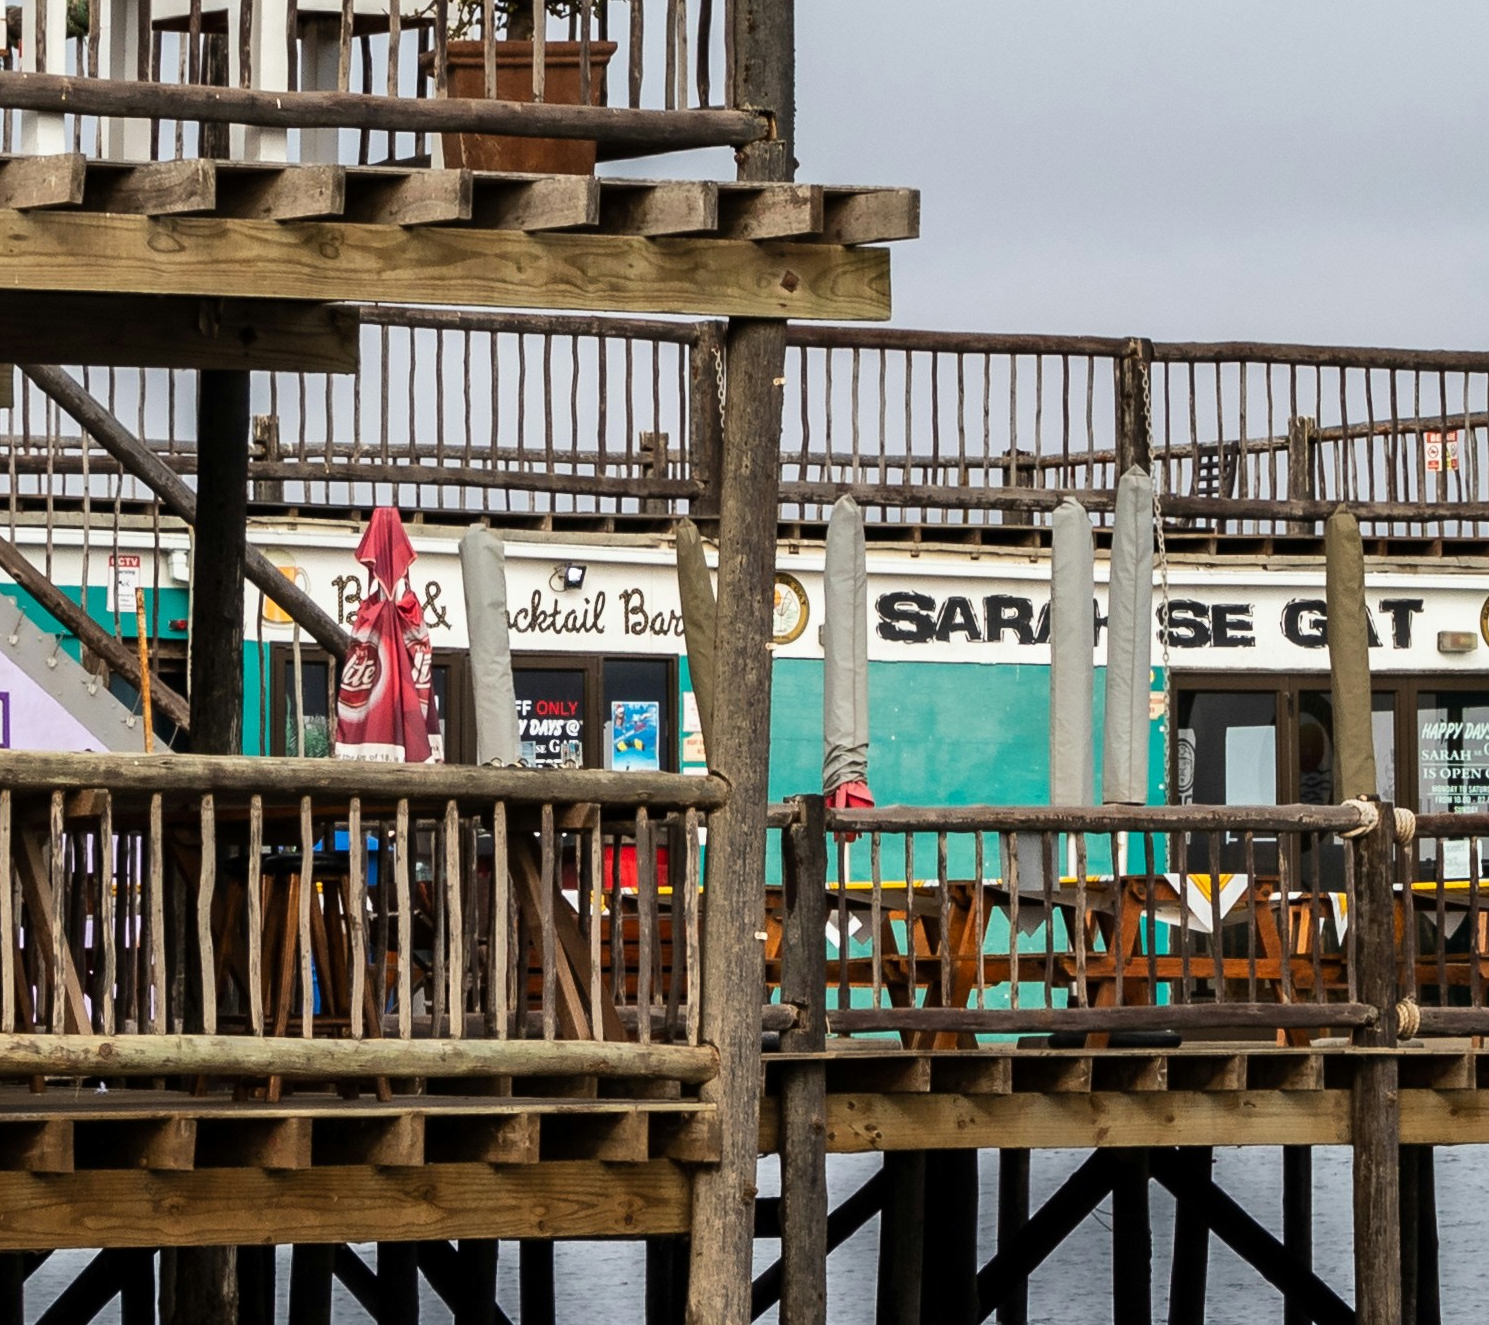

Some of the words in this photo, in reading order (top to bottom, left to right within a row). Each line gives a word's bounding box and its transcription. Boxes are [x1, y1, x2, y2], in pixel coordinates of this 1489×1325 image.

[422, 581, 452, 630] &
[505, 589, 606, 635] cktail
[875, 590, 1109, 645] SAR
[1155, 598, 1256, 648] SE
[1280, 597, 1424, 649] GT
[536, 700, 579, 716] ONLY
[530, 719, 565, 737] DAYS
[566, 719, 581, 737] @
[1421, 722, 1463, 740] HAPPY
[1421, 749, 1472, 761] SARAH
[1422, 767, 1437, 779] IS
[1439, 767, 1482, 779] OPEN
